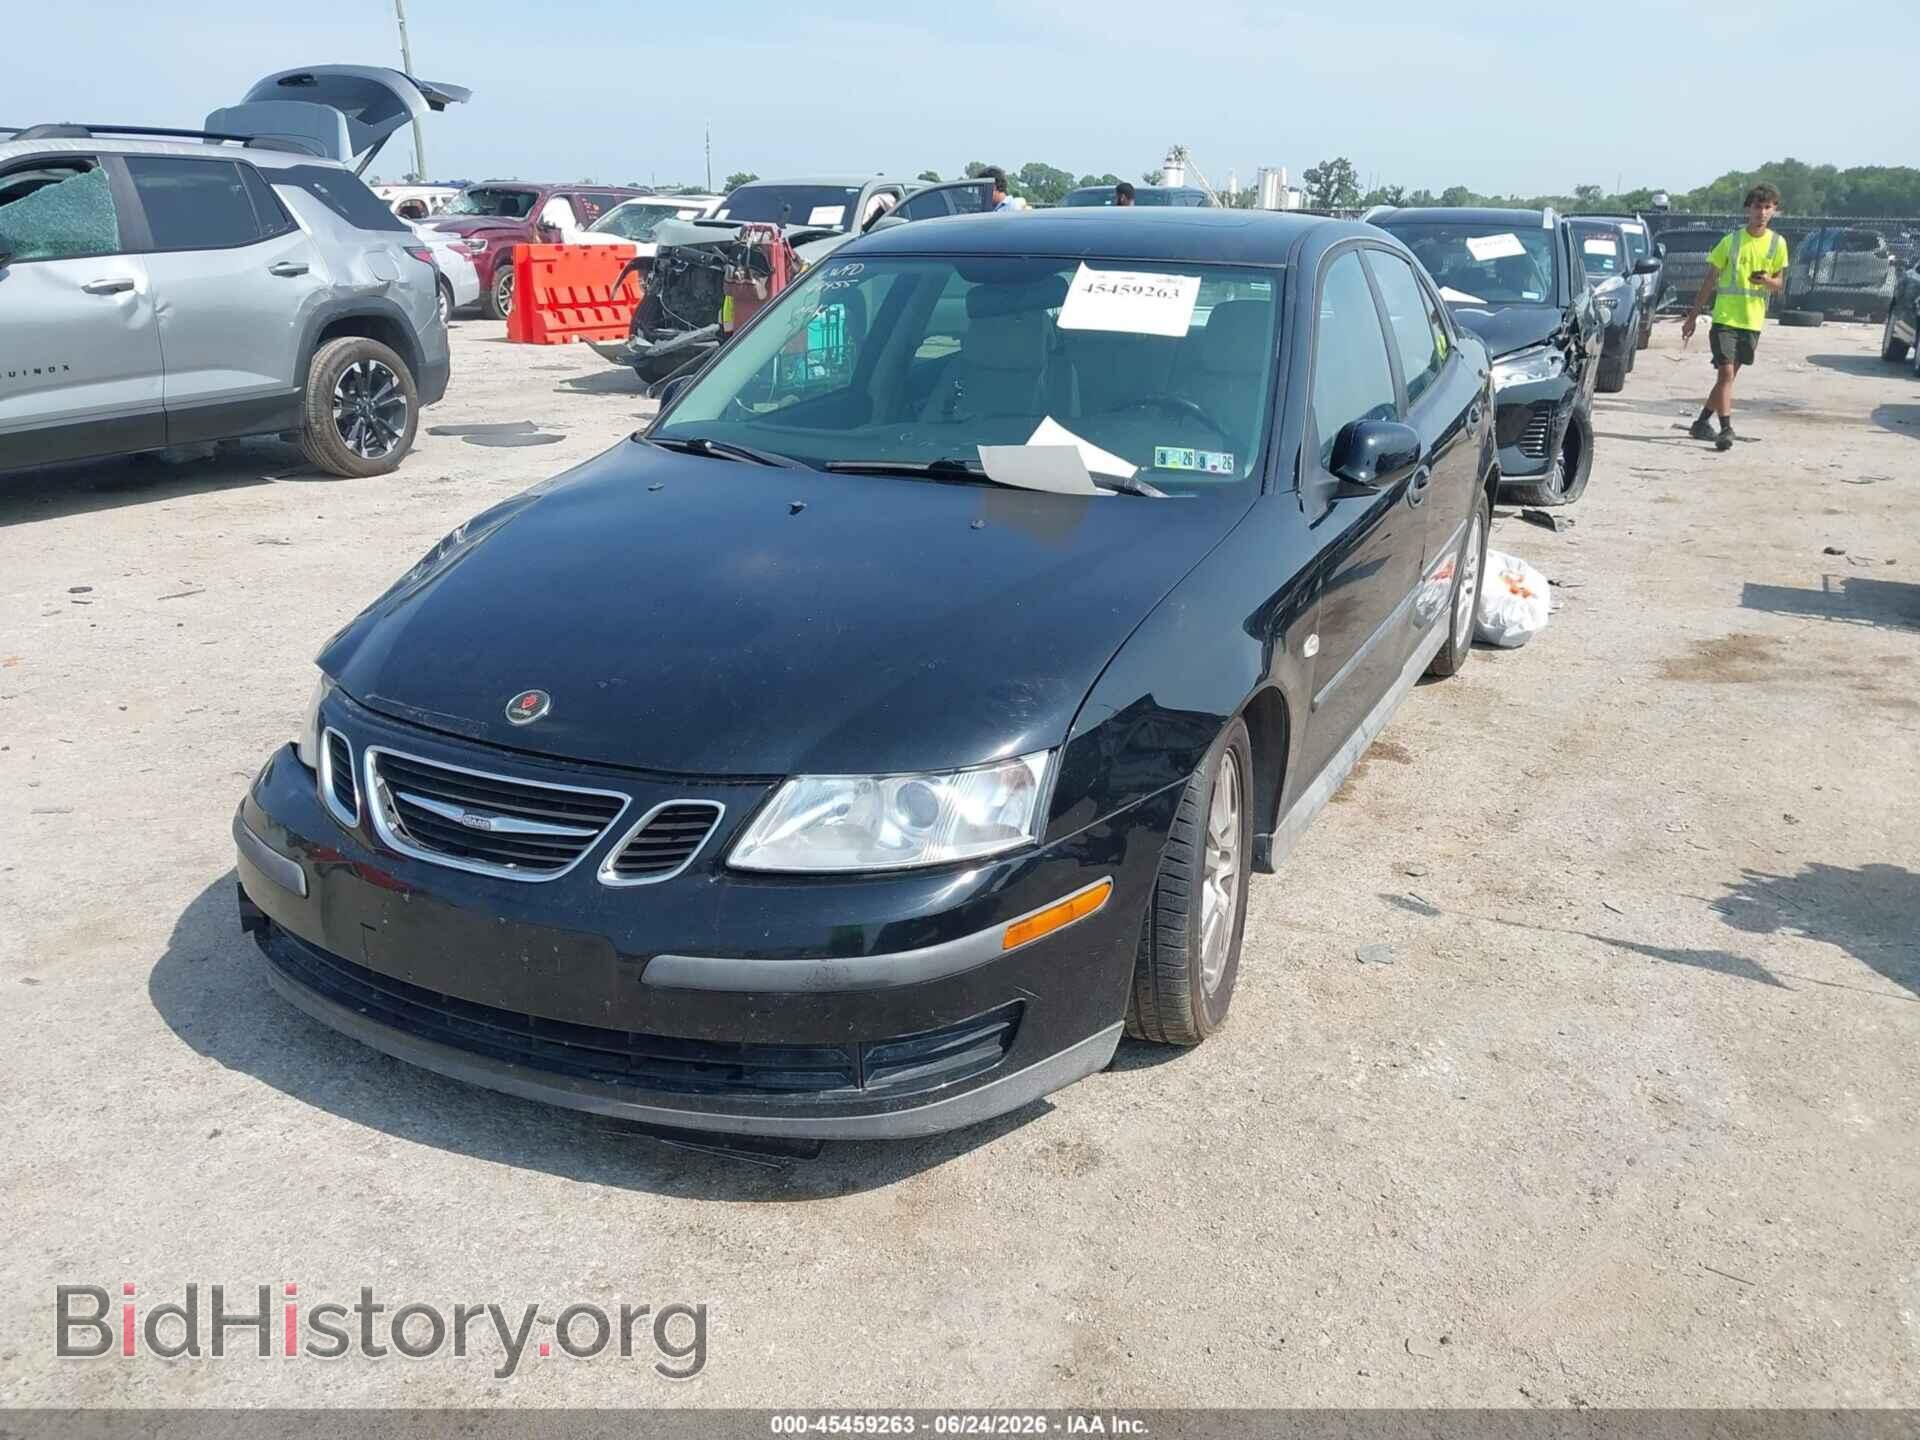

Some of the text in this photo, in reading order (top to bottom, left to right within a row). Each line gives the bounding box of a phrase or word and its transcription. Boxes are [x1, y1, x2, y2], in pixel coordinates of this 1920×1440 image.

[1081, 283, 1180, 300] 45459263
[0, 364, 70, 379] UINOX
[1183, 451, 1194, 466] 26
[1222, 456, 1233, 471] 26
